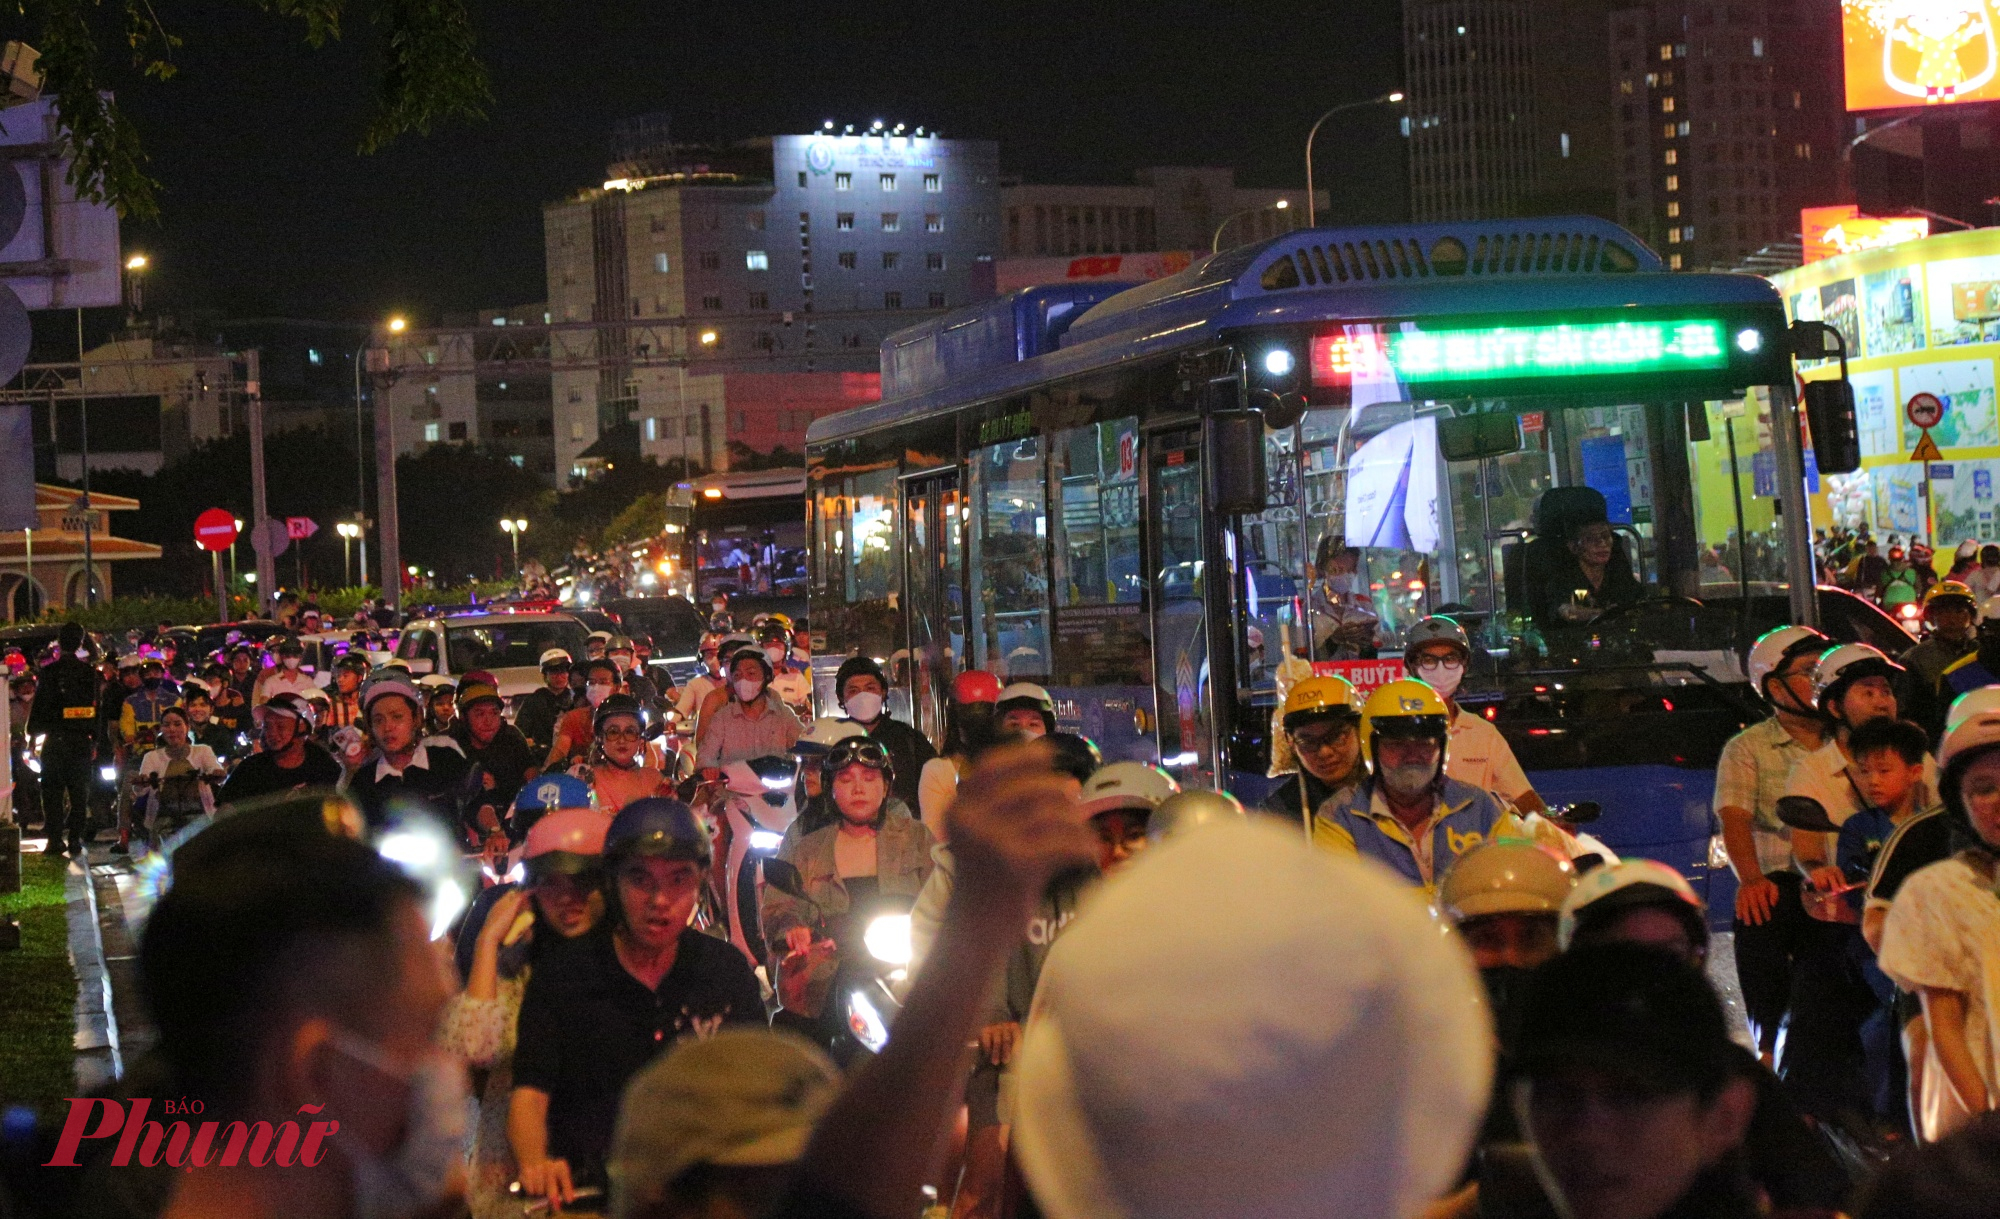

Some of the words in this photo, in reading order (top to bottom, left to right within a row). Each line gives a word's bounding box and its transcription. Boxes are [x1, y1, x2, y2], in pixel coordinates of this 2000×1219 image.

[1444, 328, 1529, 369] BUÝT
[1120, 436, 1133, 474] 03
[1351, 663, 1396, 685] BUÝT
[1398, 695, 1424, 711] be
